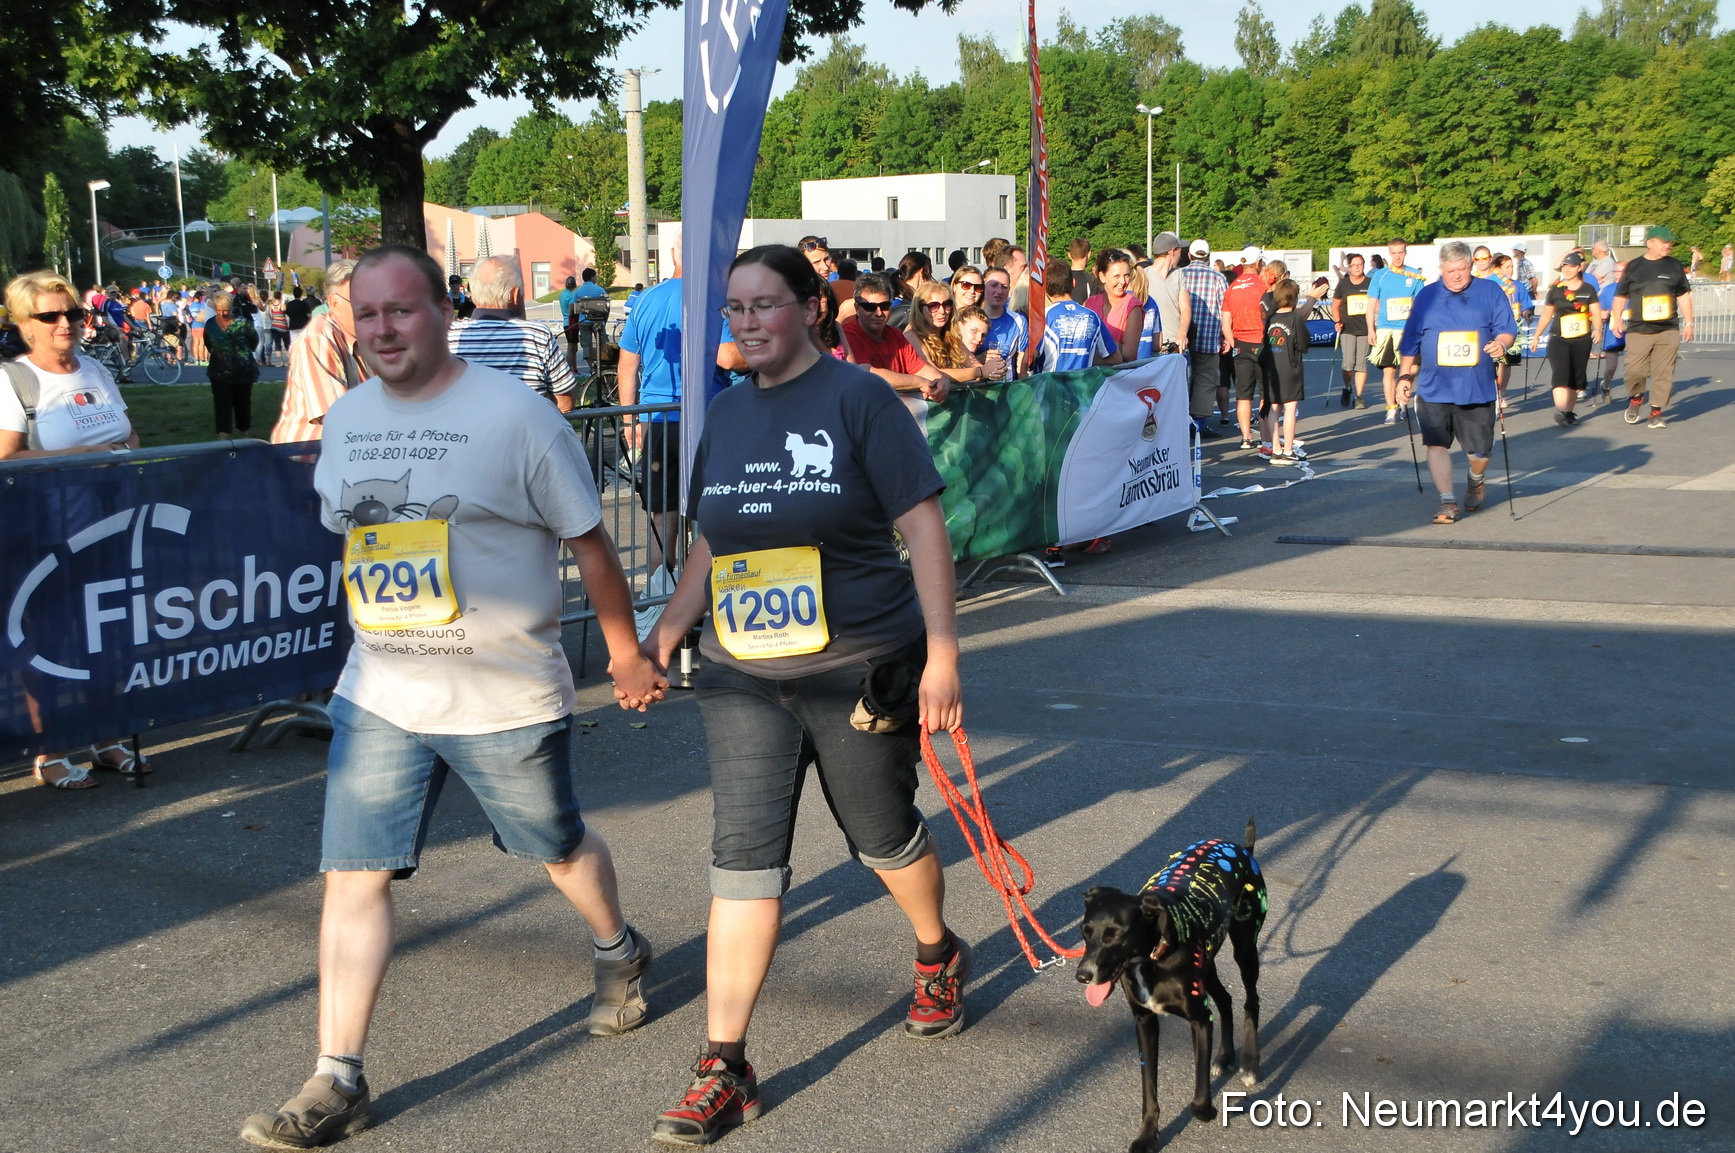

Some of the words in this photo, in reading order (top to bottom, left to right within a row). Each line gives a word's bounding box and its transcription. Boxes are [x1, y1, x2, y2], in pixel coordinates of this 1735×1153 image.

[1354, 302, 1364, 310] 70
[1568, 322, 1580, 332] 82
[1444, 344, 1471, 358] 129
[75, 412, 118, 427] POLGER
[344, 431, 382, 444] Service
[386, 430, 405, 442] für
[407, 430, 416, 441] 4
[420, 429, 469, 444] Pfoten
[349, 447, 449, 462] 0162-2014027
[1128, 446, 1170, 477] Neumarkter
[745, 461, 782, 474] www.
[702, 477, 842, 497] rvice-fuer-4-pfoten
[738, 502, 772, 513] .com
[348, 558, 443, 604] 1291
[84, 555, 345, 654] Fischer
[718, 585, 817, 633] 1290
[124, 622, 335, 692] AUTOMOBILE
